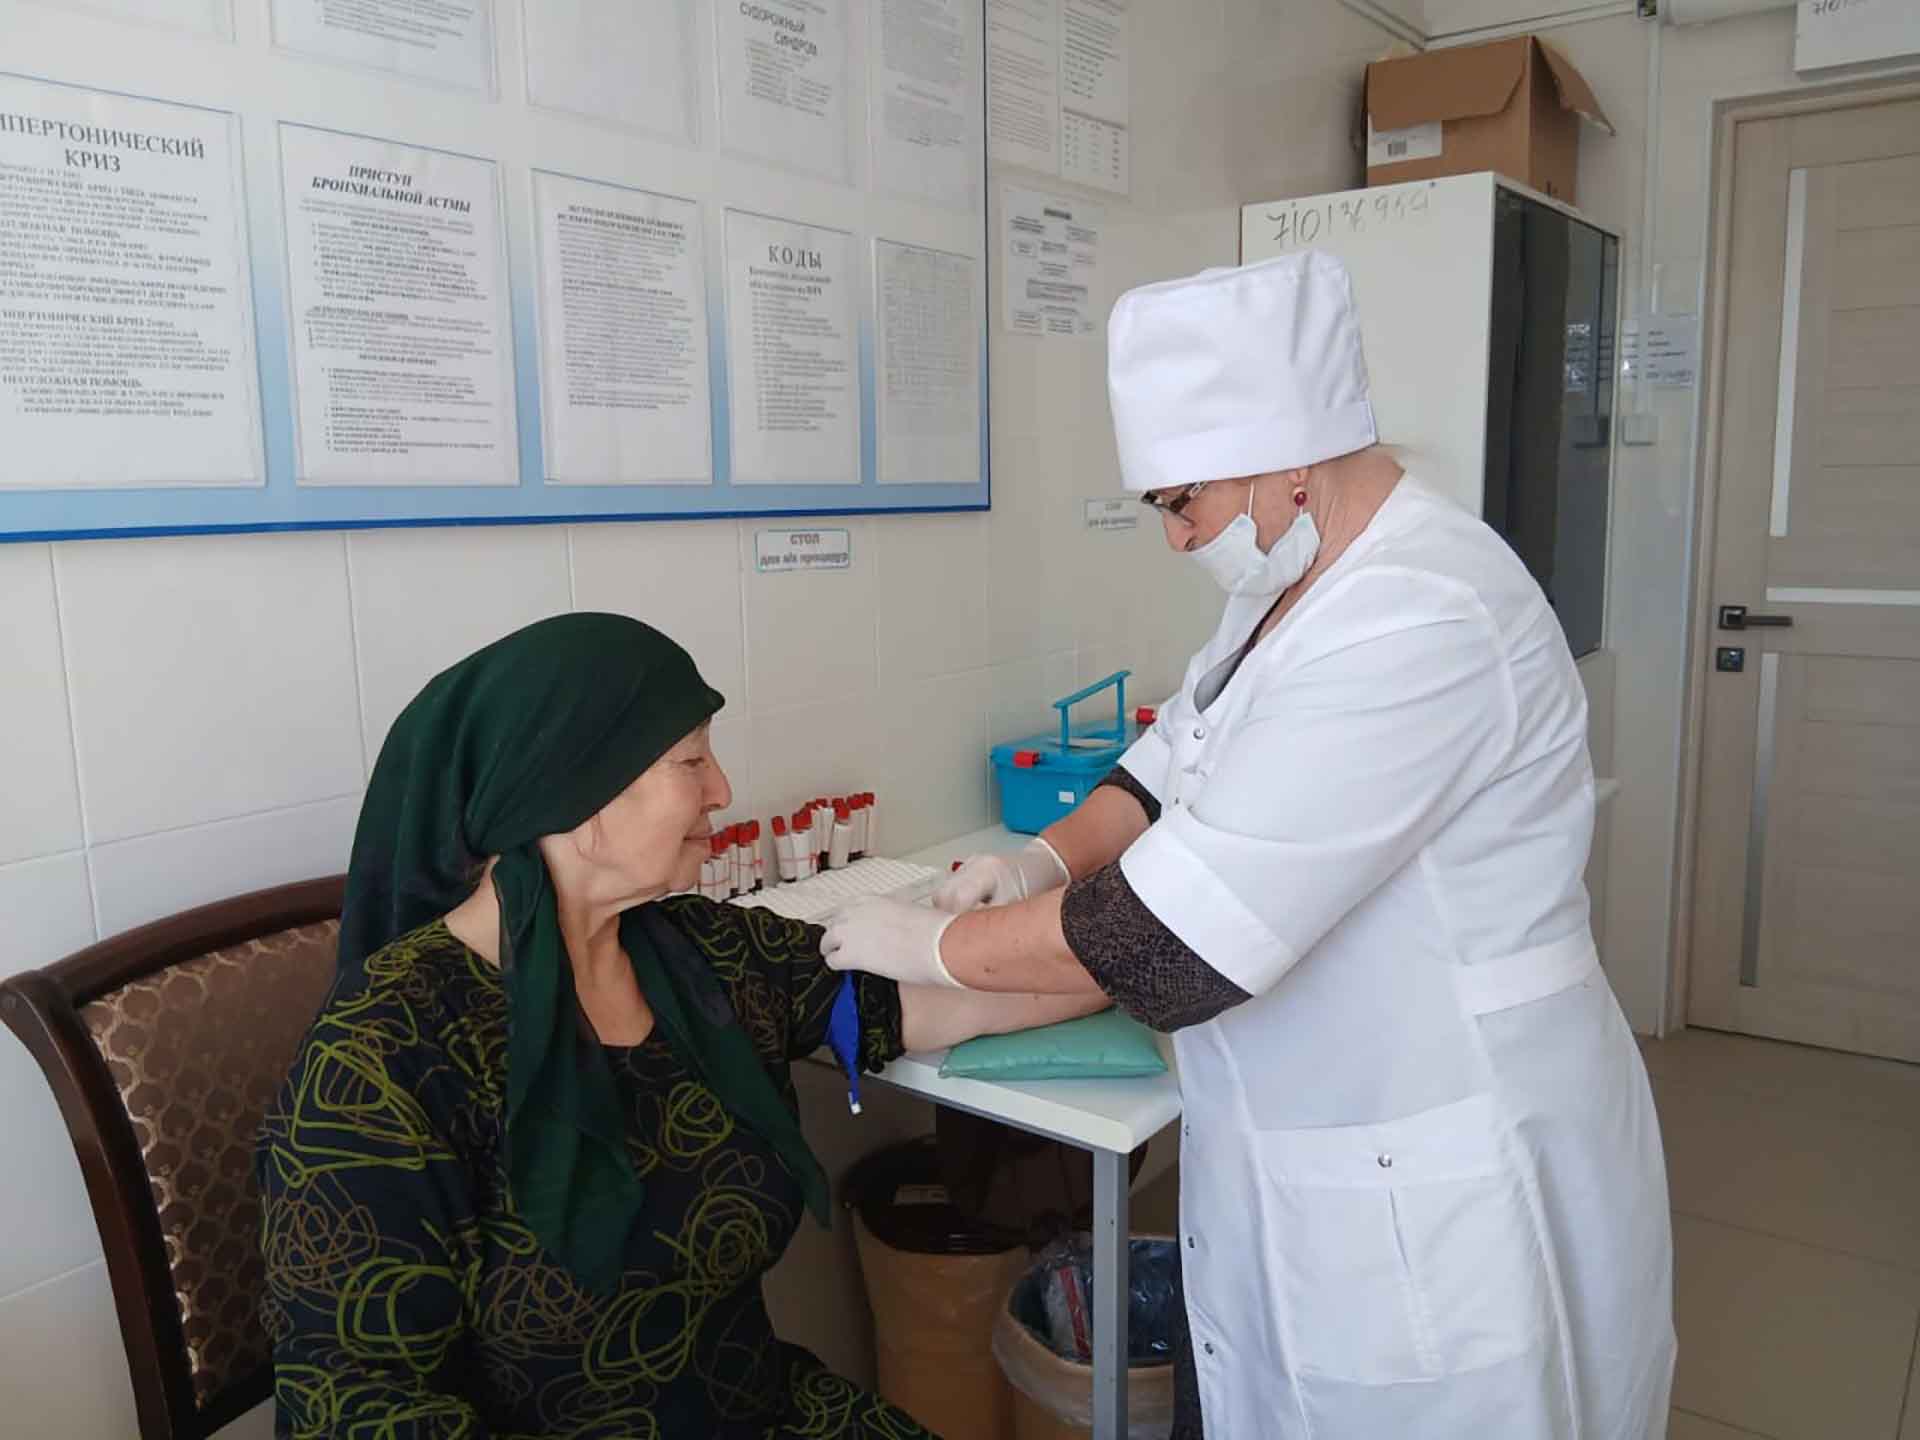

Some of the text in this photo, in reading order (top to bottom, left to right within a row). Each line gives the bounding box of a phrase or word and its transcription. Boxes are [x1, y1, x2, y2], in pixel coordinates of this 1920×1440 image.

[65, 147, 121, 173] КРИЗ
[348, 164, 412, 188] ПРИСТУП
[311, 175, 472, 214] БРОНХИАЛЬНОЙ АСТМЫ
[768, 244, 822, 270] КОДЫ
